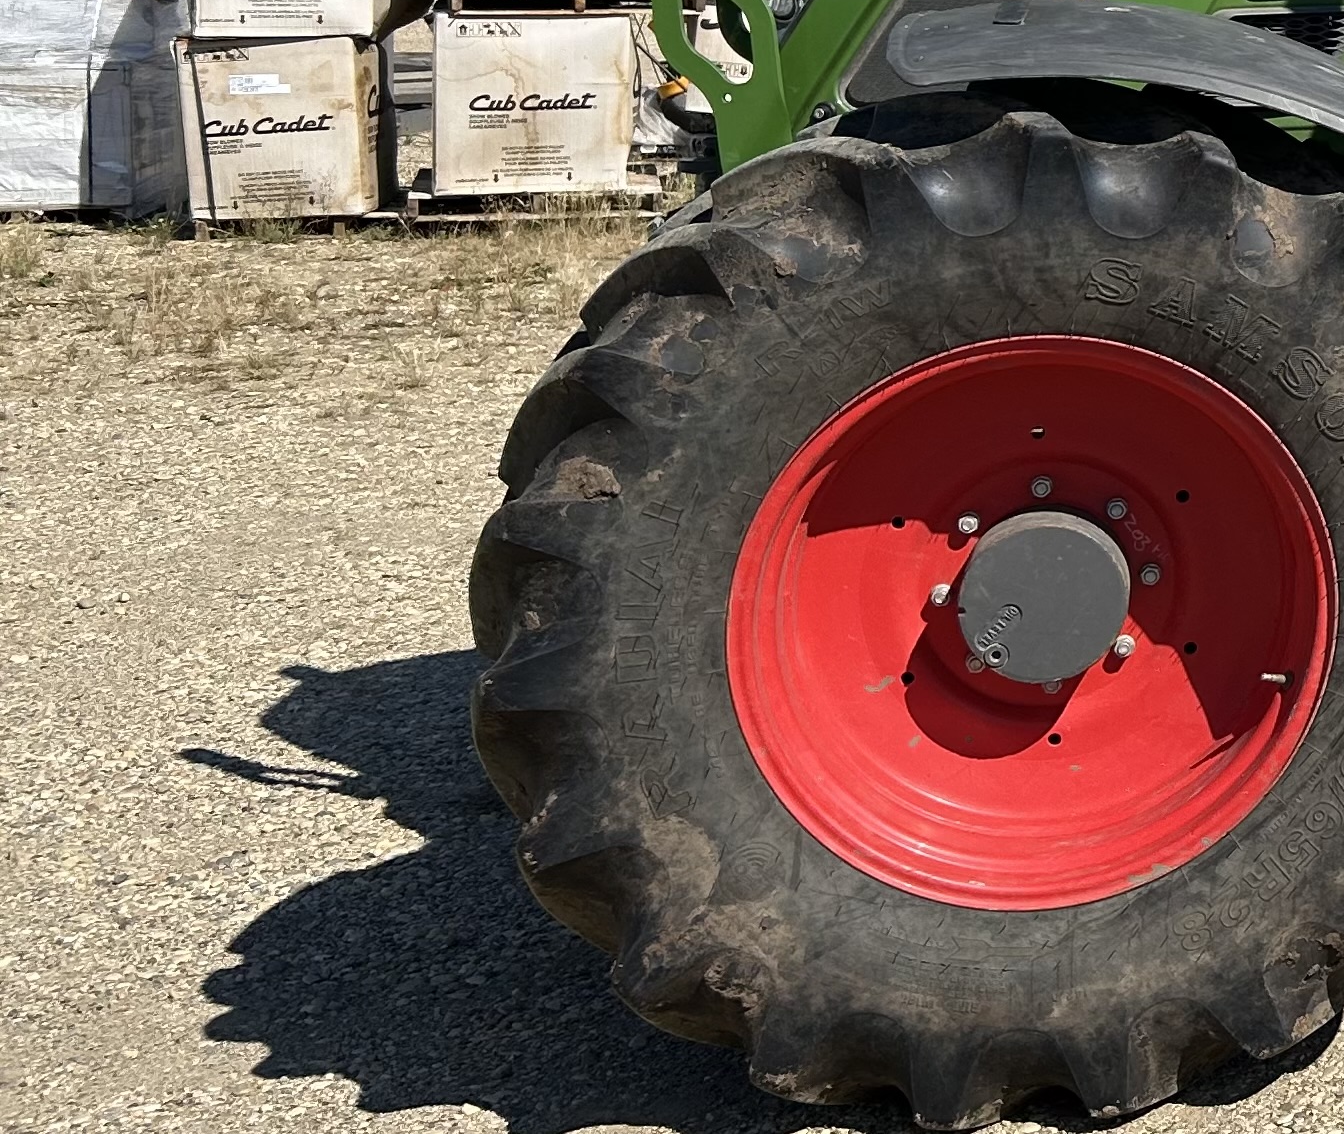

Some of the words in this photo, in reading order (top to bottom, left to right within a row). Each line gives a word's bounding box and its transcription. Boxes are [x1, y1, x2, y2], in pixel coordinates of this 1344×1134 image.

[469, 94, 516, 112] Cub
[519, 92, 598, 111] Cadet
[204, 118, 249, 138] Cub
[252, 113, 334, 135] Cadet
